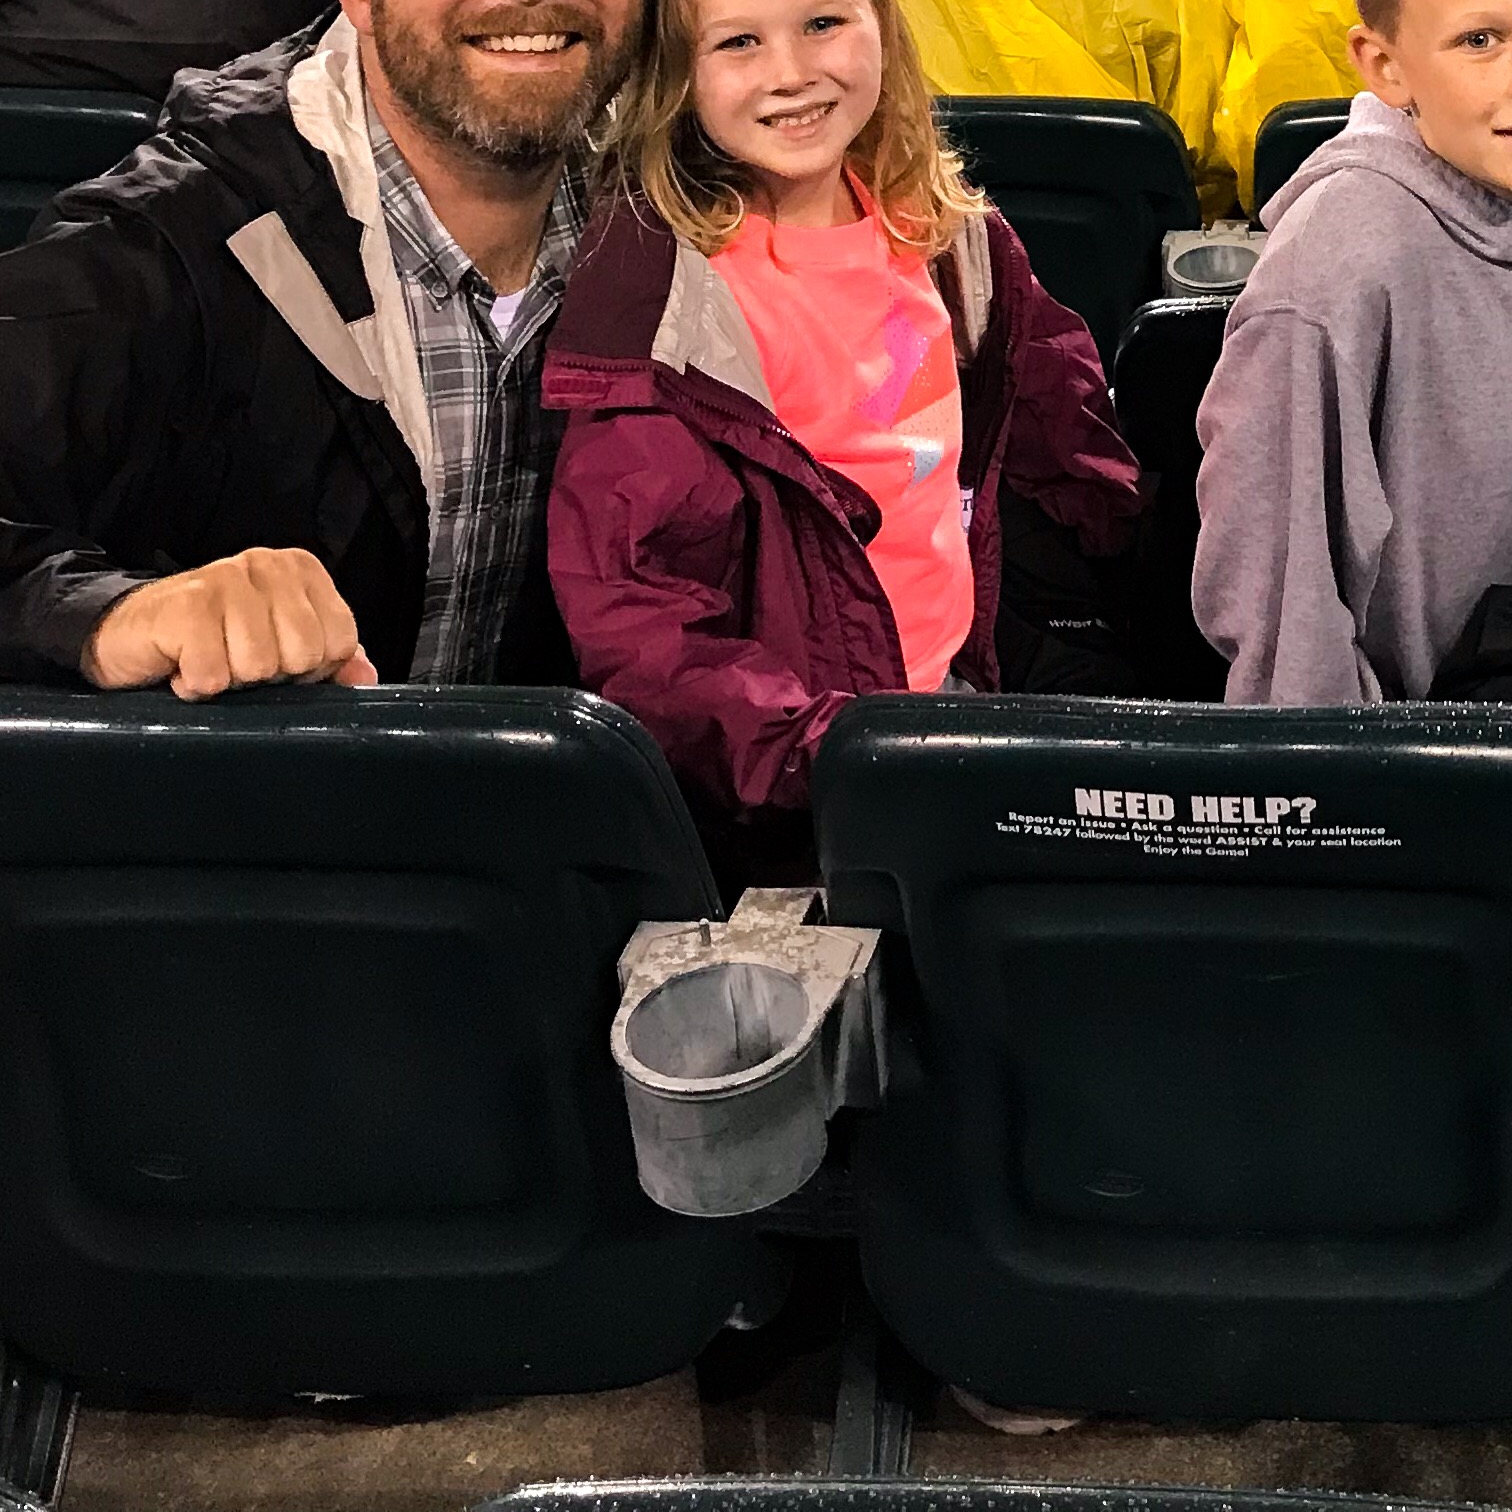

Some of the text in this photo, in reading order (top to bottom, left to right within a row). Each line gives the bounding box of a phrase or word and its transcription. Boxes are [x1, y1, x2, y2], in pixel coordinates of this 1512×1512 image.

[1075, 788, 1317, 824] NEED HELP?
[995, 822, 1020, 833] Text
[1075, 828, 1131, 841] followed
[1133, 832, 1151, 844] by
[1154, 833, 1174, 844] the
[1178, 835, 1212, 846] word
[1215, 836, 1269, 846] ASSIST
[1271, 837, 1283, 847] &
[1286, 838, 1316, 849] your
[1320, 838, 1347, 847] seat
[1350, 836, 1402, 847] location
[1008, 811, 1054, 825] Report
[1058, 817, 1077, 827] an
[1131, 821, 1158, 832] Ask
[1162, 824, 1173, 832] a
[1176, 824, 1239, 835] question
[1254, 825, 1281, 835] Call
[1286, 825, 1308, 835] for
[1311, 825, 1386, 835] assistance
[1143, 844, 1249, 857] Enjoy the Game!
